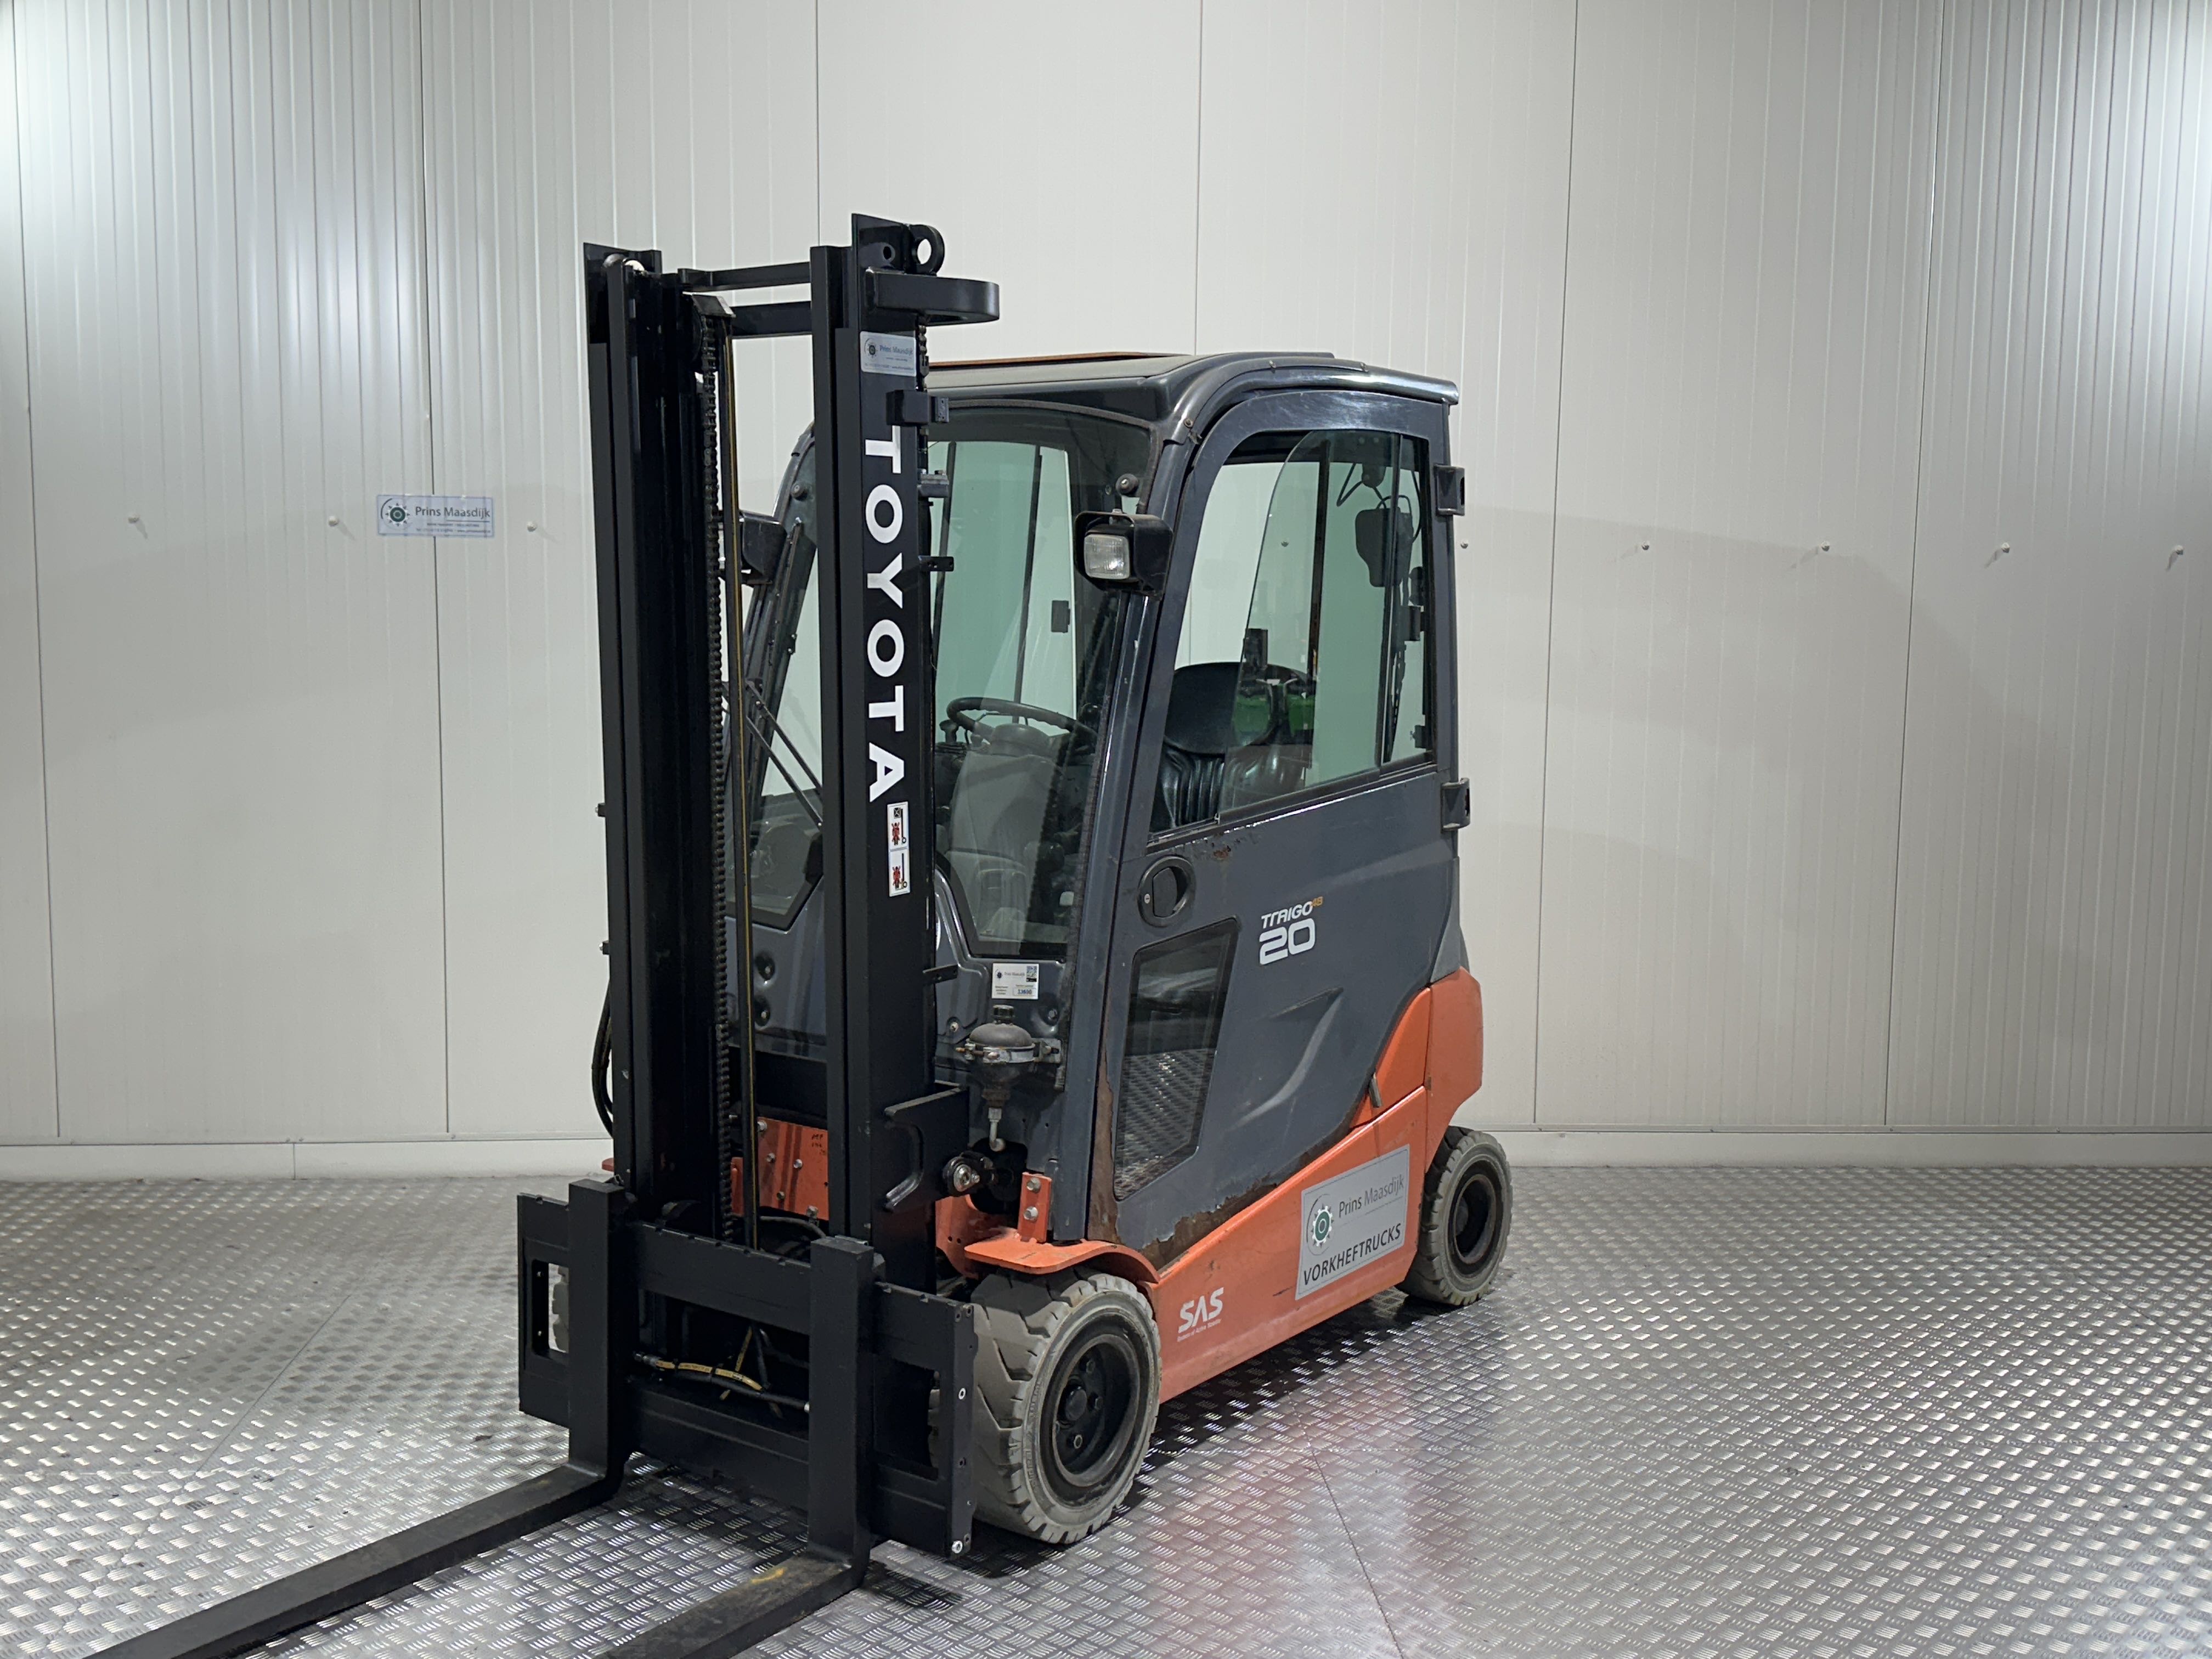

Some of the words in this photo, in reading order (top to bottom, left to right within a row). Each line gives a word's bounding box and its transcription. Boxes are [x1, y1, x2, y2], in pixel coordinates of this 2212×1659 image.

[415, 506, 441, 516] Prins
[444, 507, 490, 519] Maasdijk
[865, 425, 904, 802] TOYOTA
[1259, 918, 1316, 965] 20
[1339, 1197, 1362, 1218] Prins
[1364, 1174, 1404, 1206] Maasdijk
[1304, 1223, 1402, 1285] VORKHEFTRUCKS
[1178, 1287, 1224, 1334] SAS
